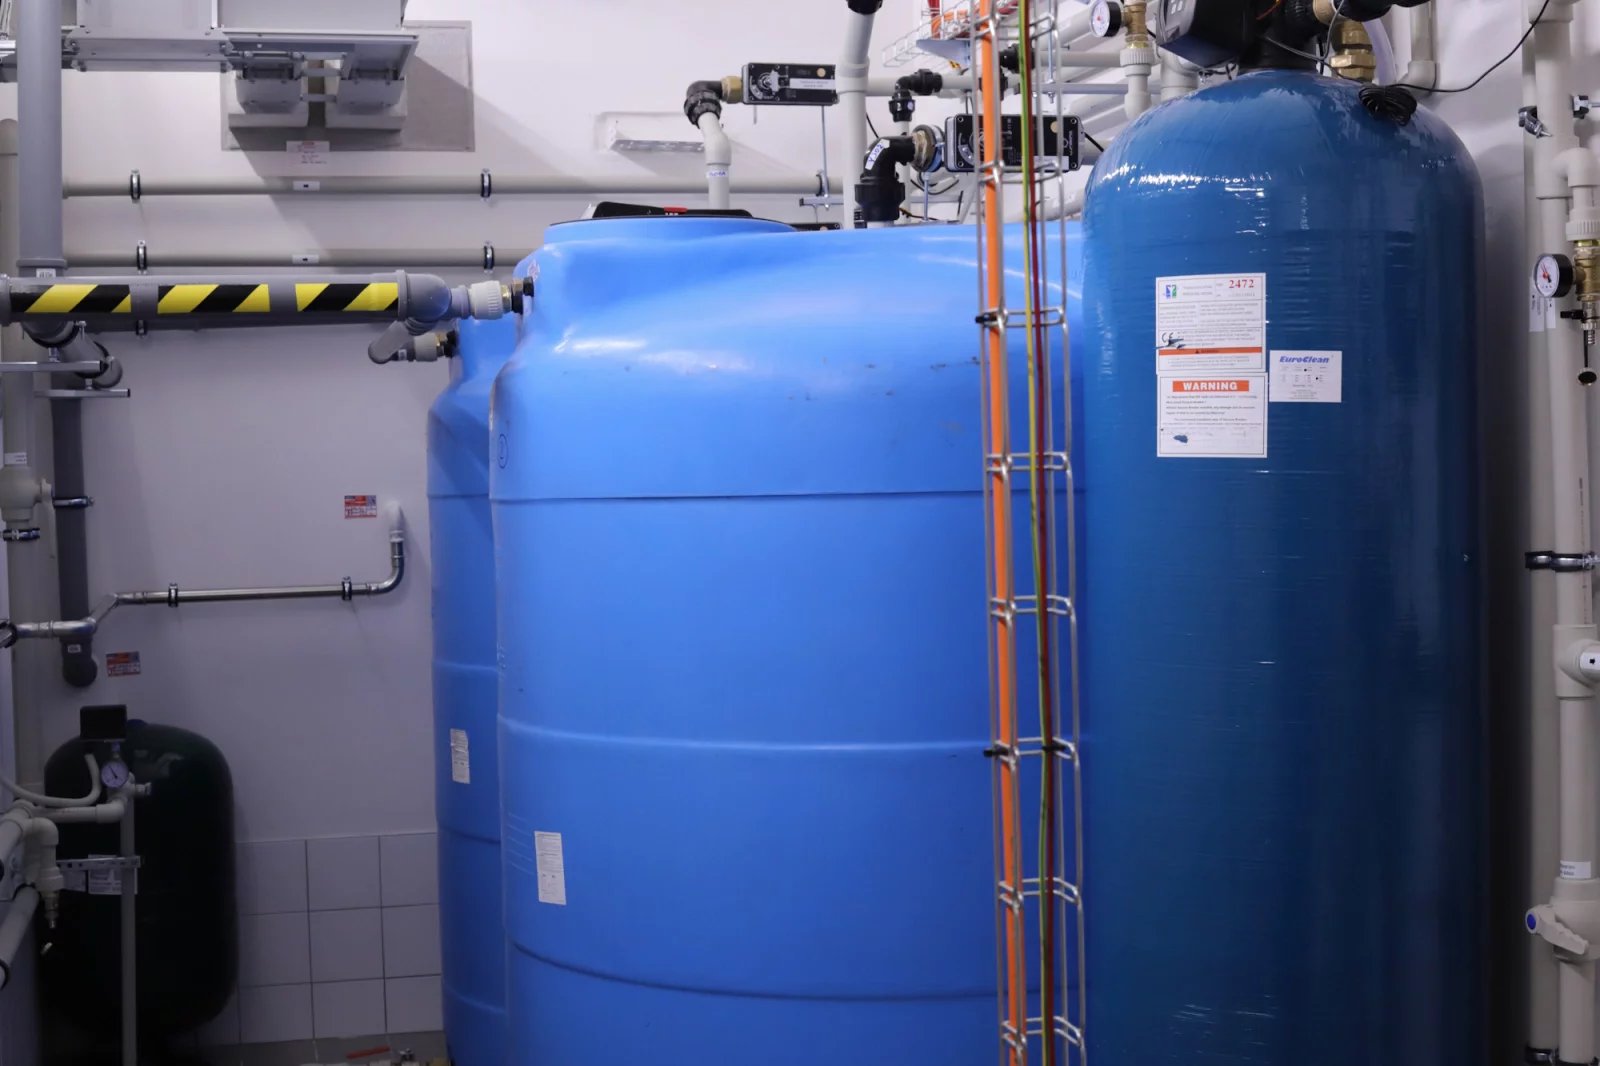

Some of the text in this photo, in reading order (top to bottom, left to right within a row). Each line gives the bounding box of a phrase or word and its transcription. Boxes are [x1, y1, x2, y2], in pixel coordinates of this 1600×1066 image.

[1228, 279, 1255, 289] 2472
[1279, 355, 1330, 364] EuroClean
[1182, 381, 1238, 391] WARNING
